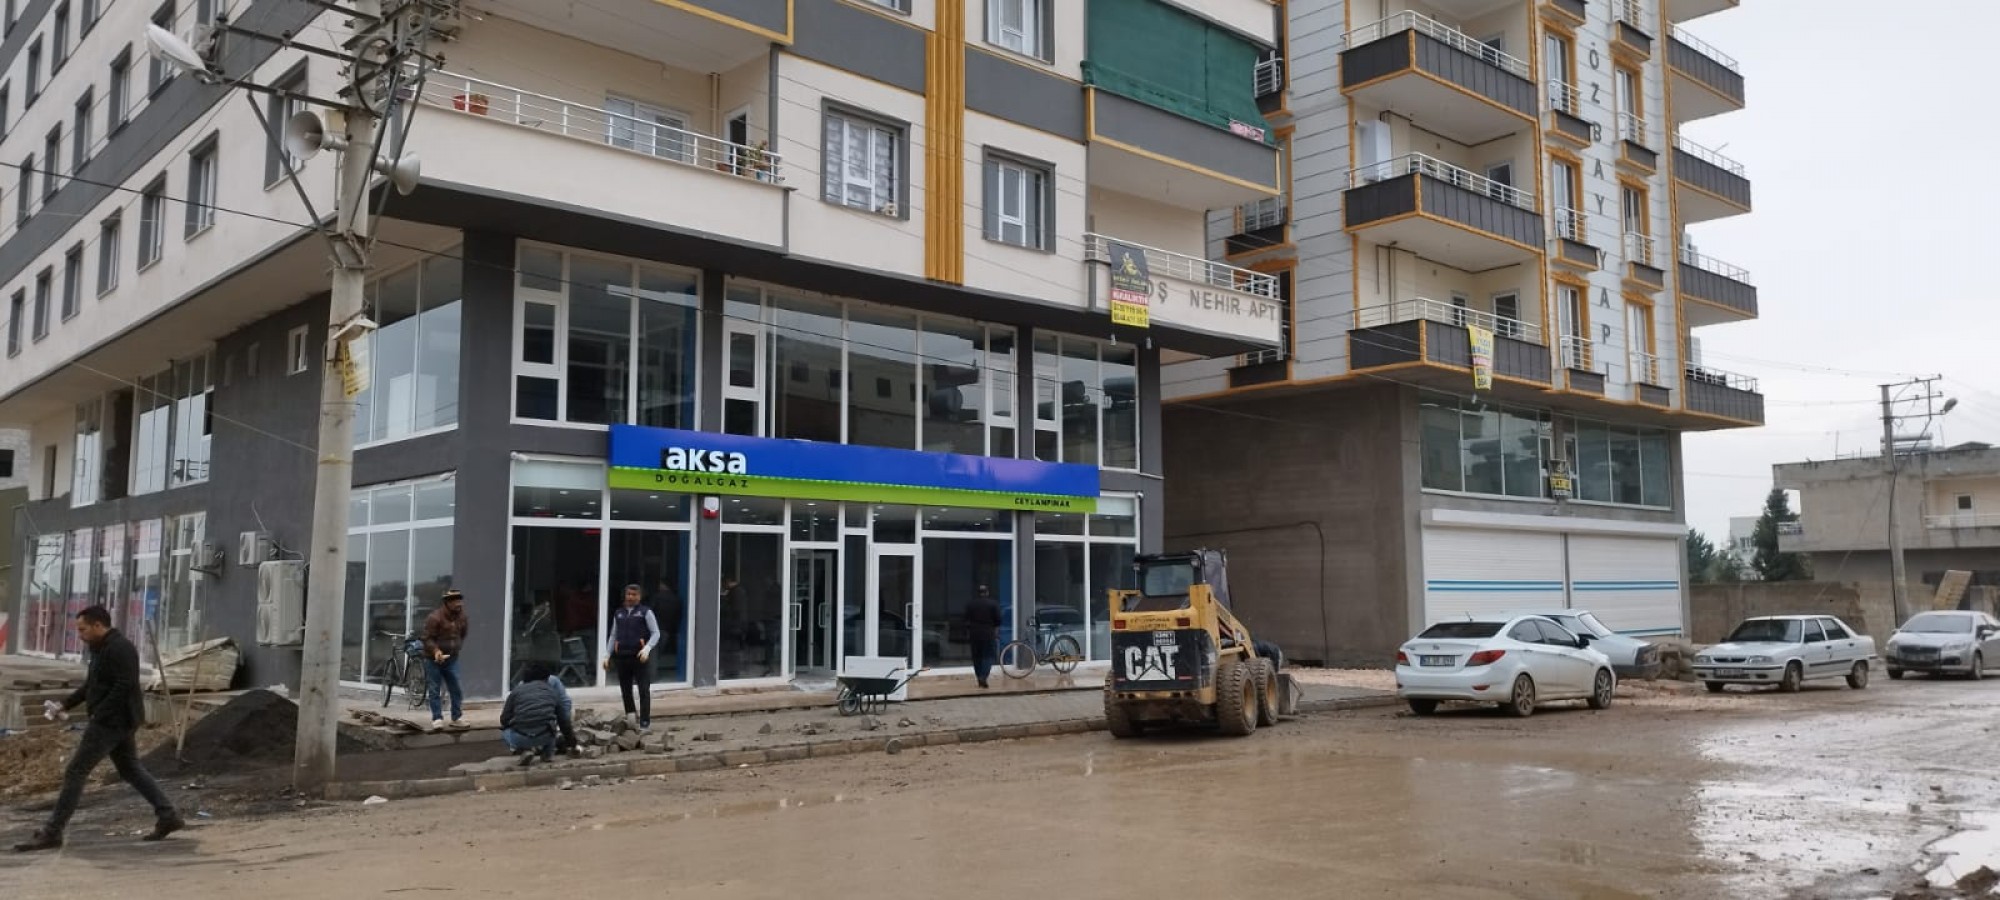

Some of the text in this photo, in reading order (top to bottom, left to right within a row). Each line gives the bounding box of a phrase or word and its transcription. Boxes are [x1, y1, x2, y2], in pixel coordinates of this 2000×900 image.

[1249, 300, 1276, 321] APT
[665, 447, 747, 475] aksa
[1124, 645, 1179, 681] CAT
